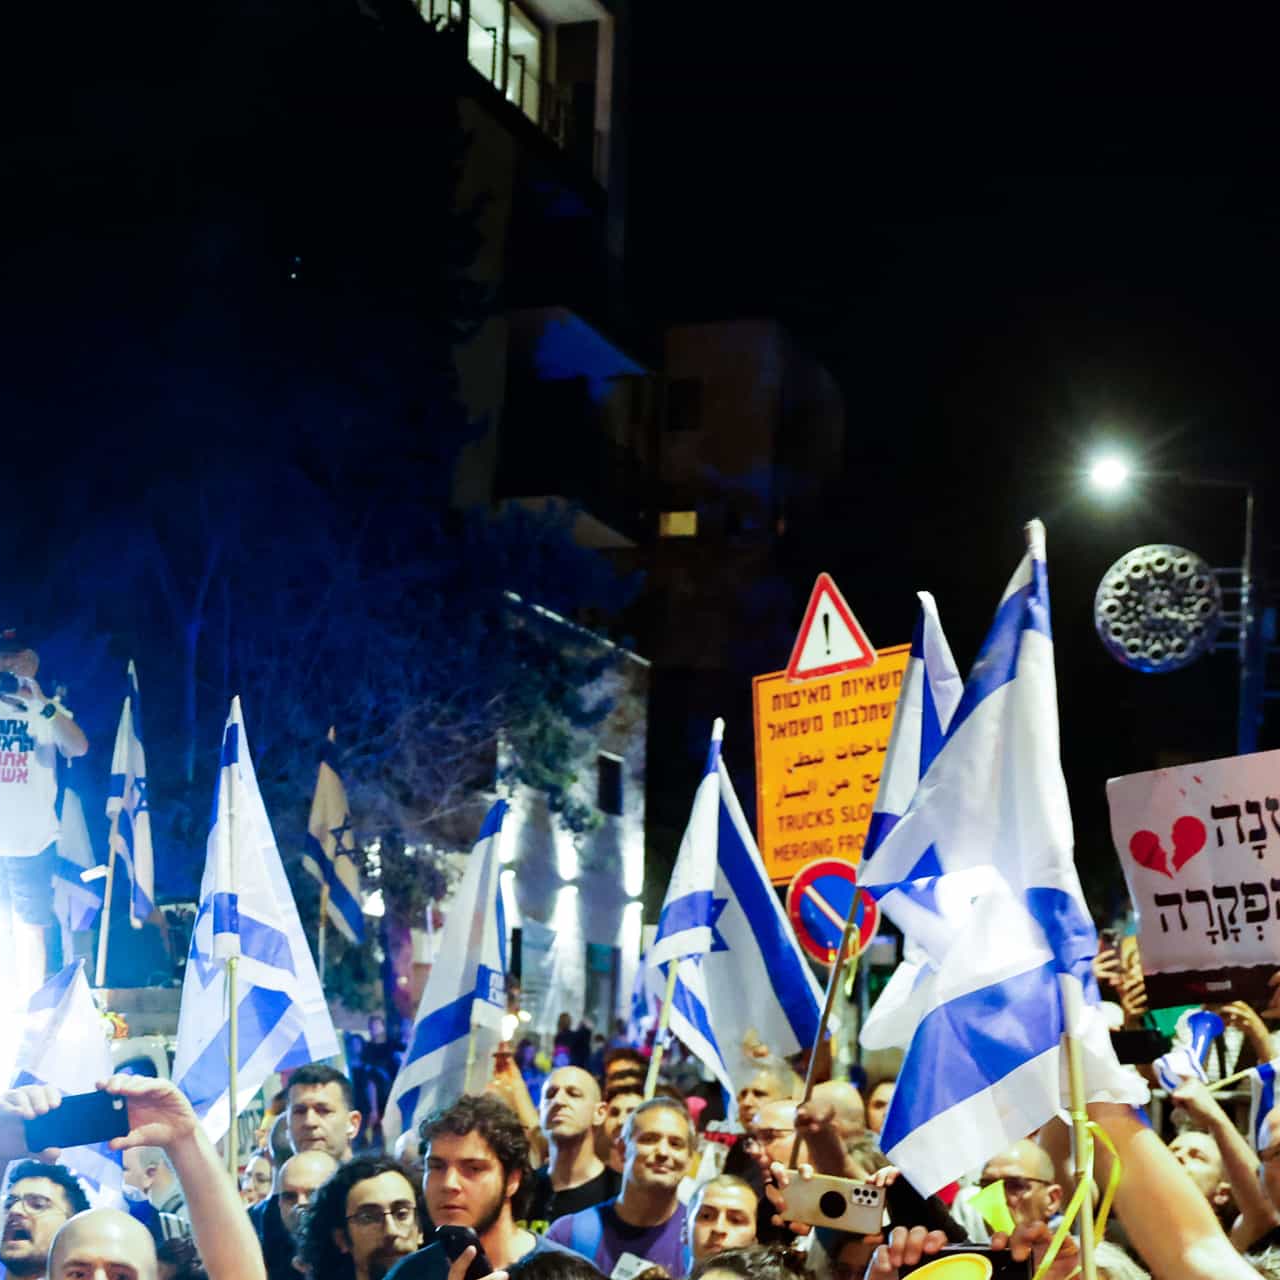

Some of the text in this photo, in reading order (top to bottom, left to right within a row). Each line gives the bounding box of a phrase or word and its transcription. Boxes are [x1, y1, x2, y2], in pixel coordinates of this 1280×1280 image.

[832, 701, 897, 729] שתלבות
[778, 803, 873, 832] TRUCKS SLO
[773, 833, 866, 861] MERGING FRO
